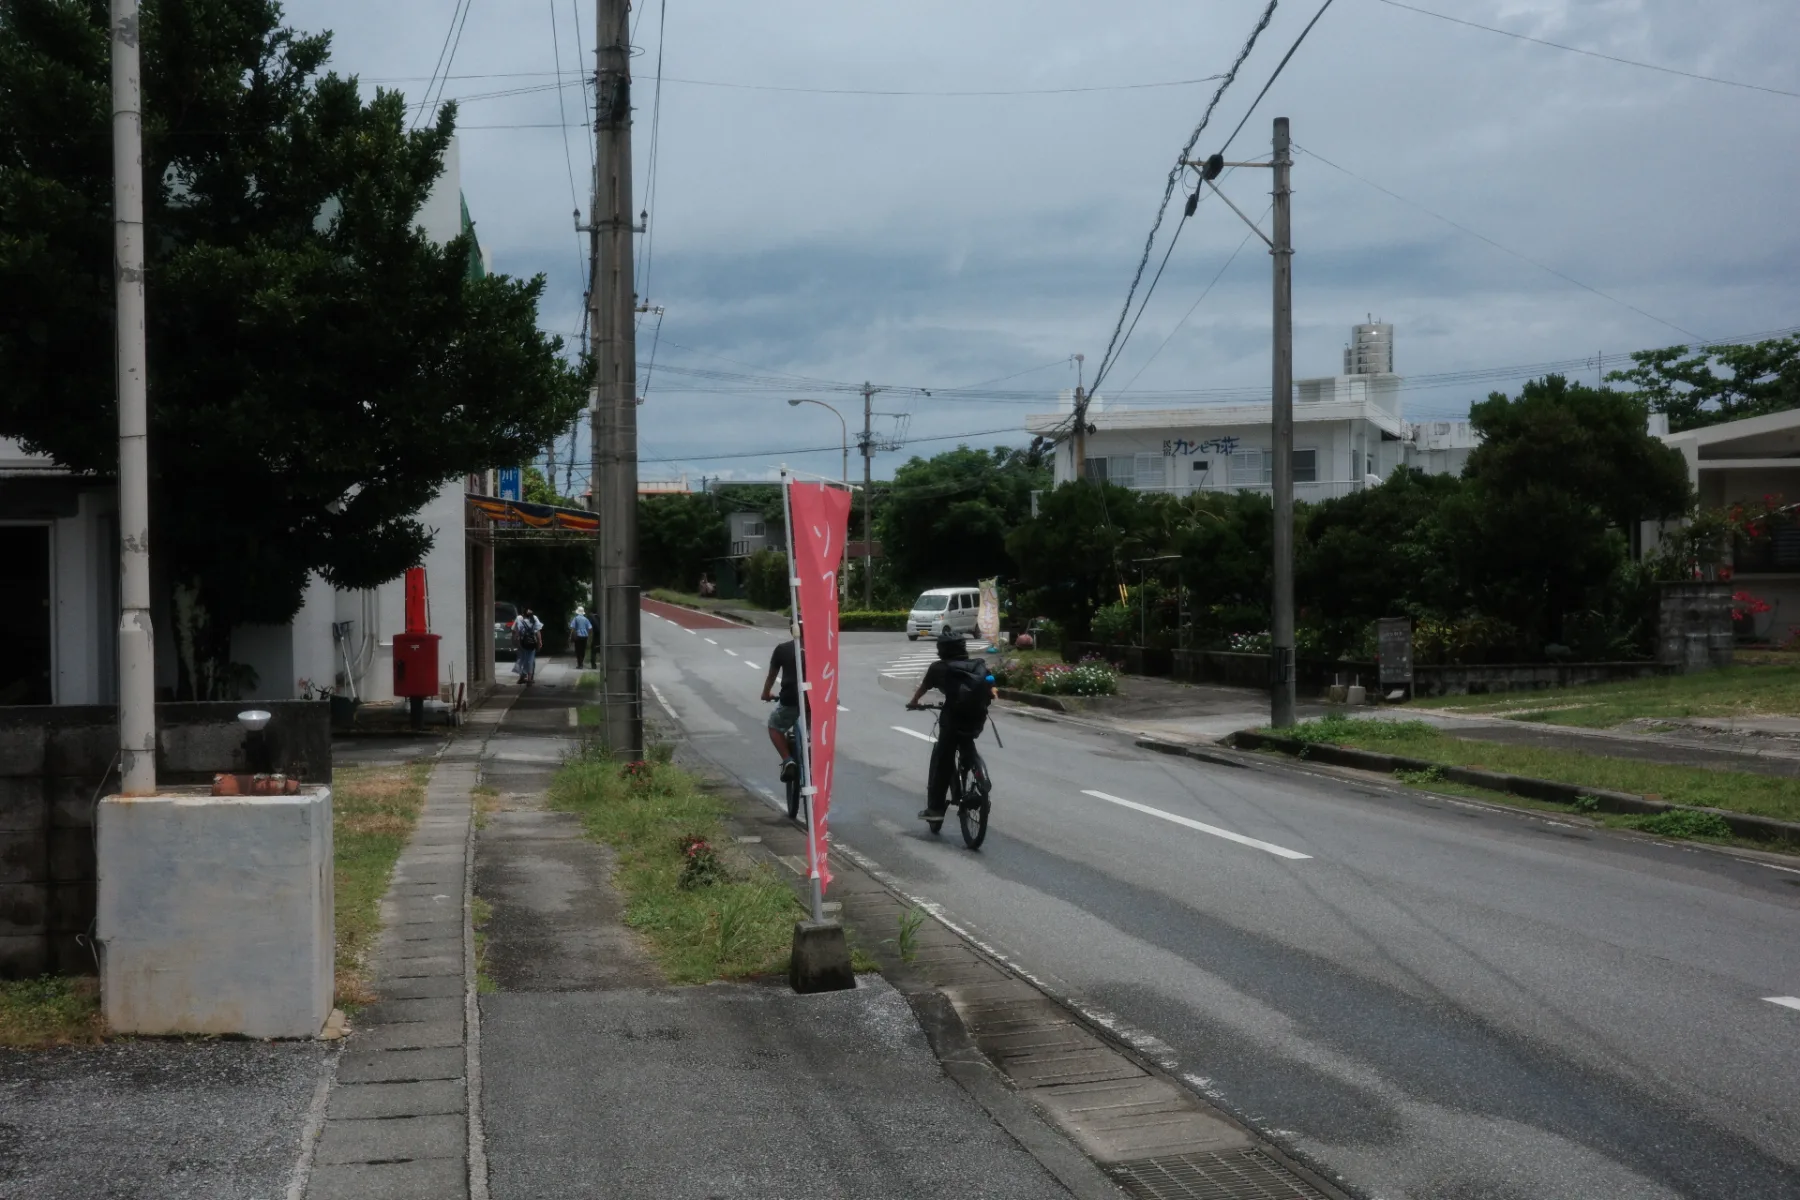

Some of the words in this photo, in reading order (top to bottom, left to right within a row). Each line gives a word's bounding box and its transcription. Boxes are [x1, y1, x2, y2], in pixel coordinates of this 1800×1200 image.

[1171, 436, 1240, 457] カンピラ荘
